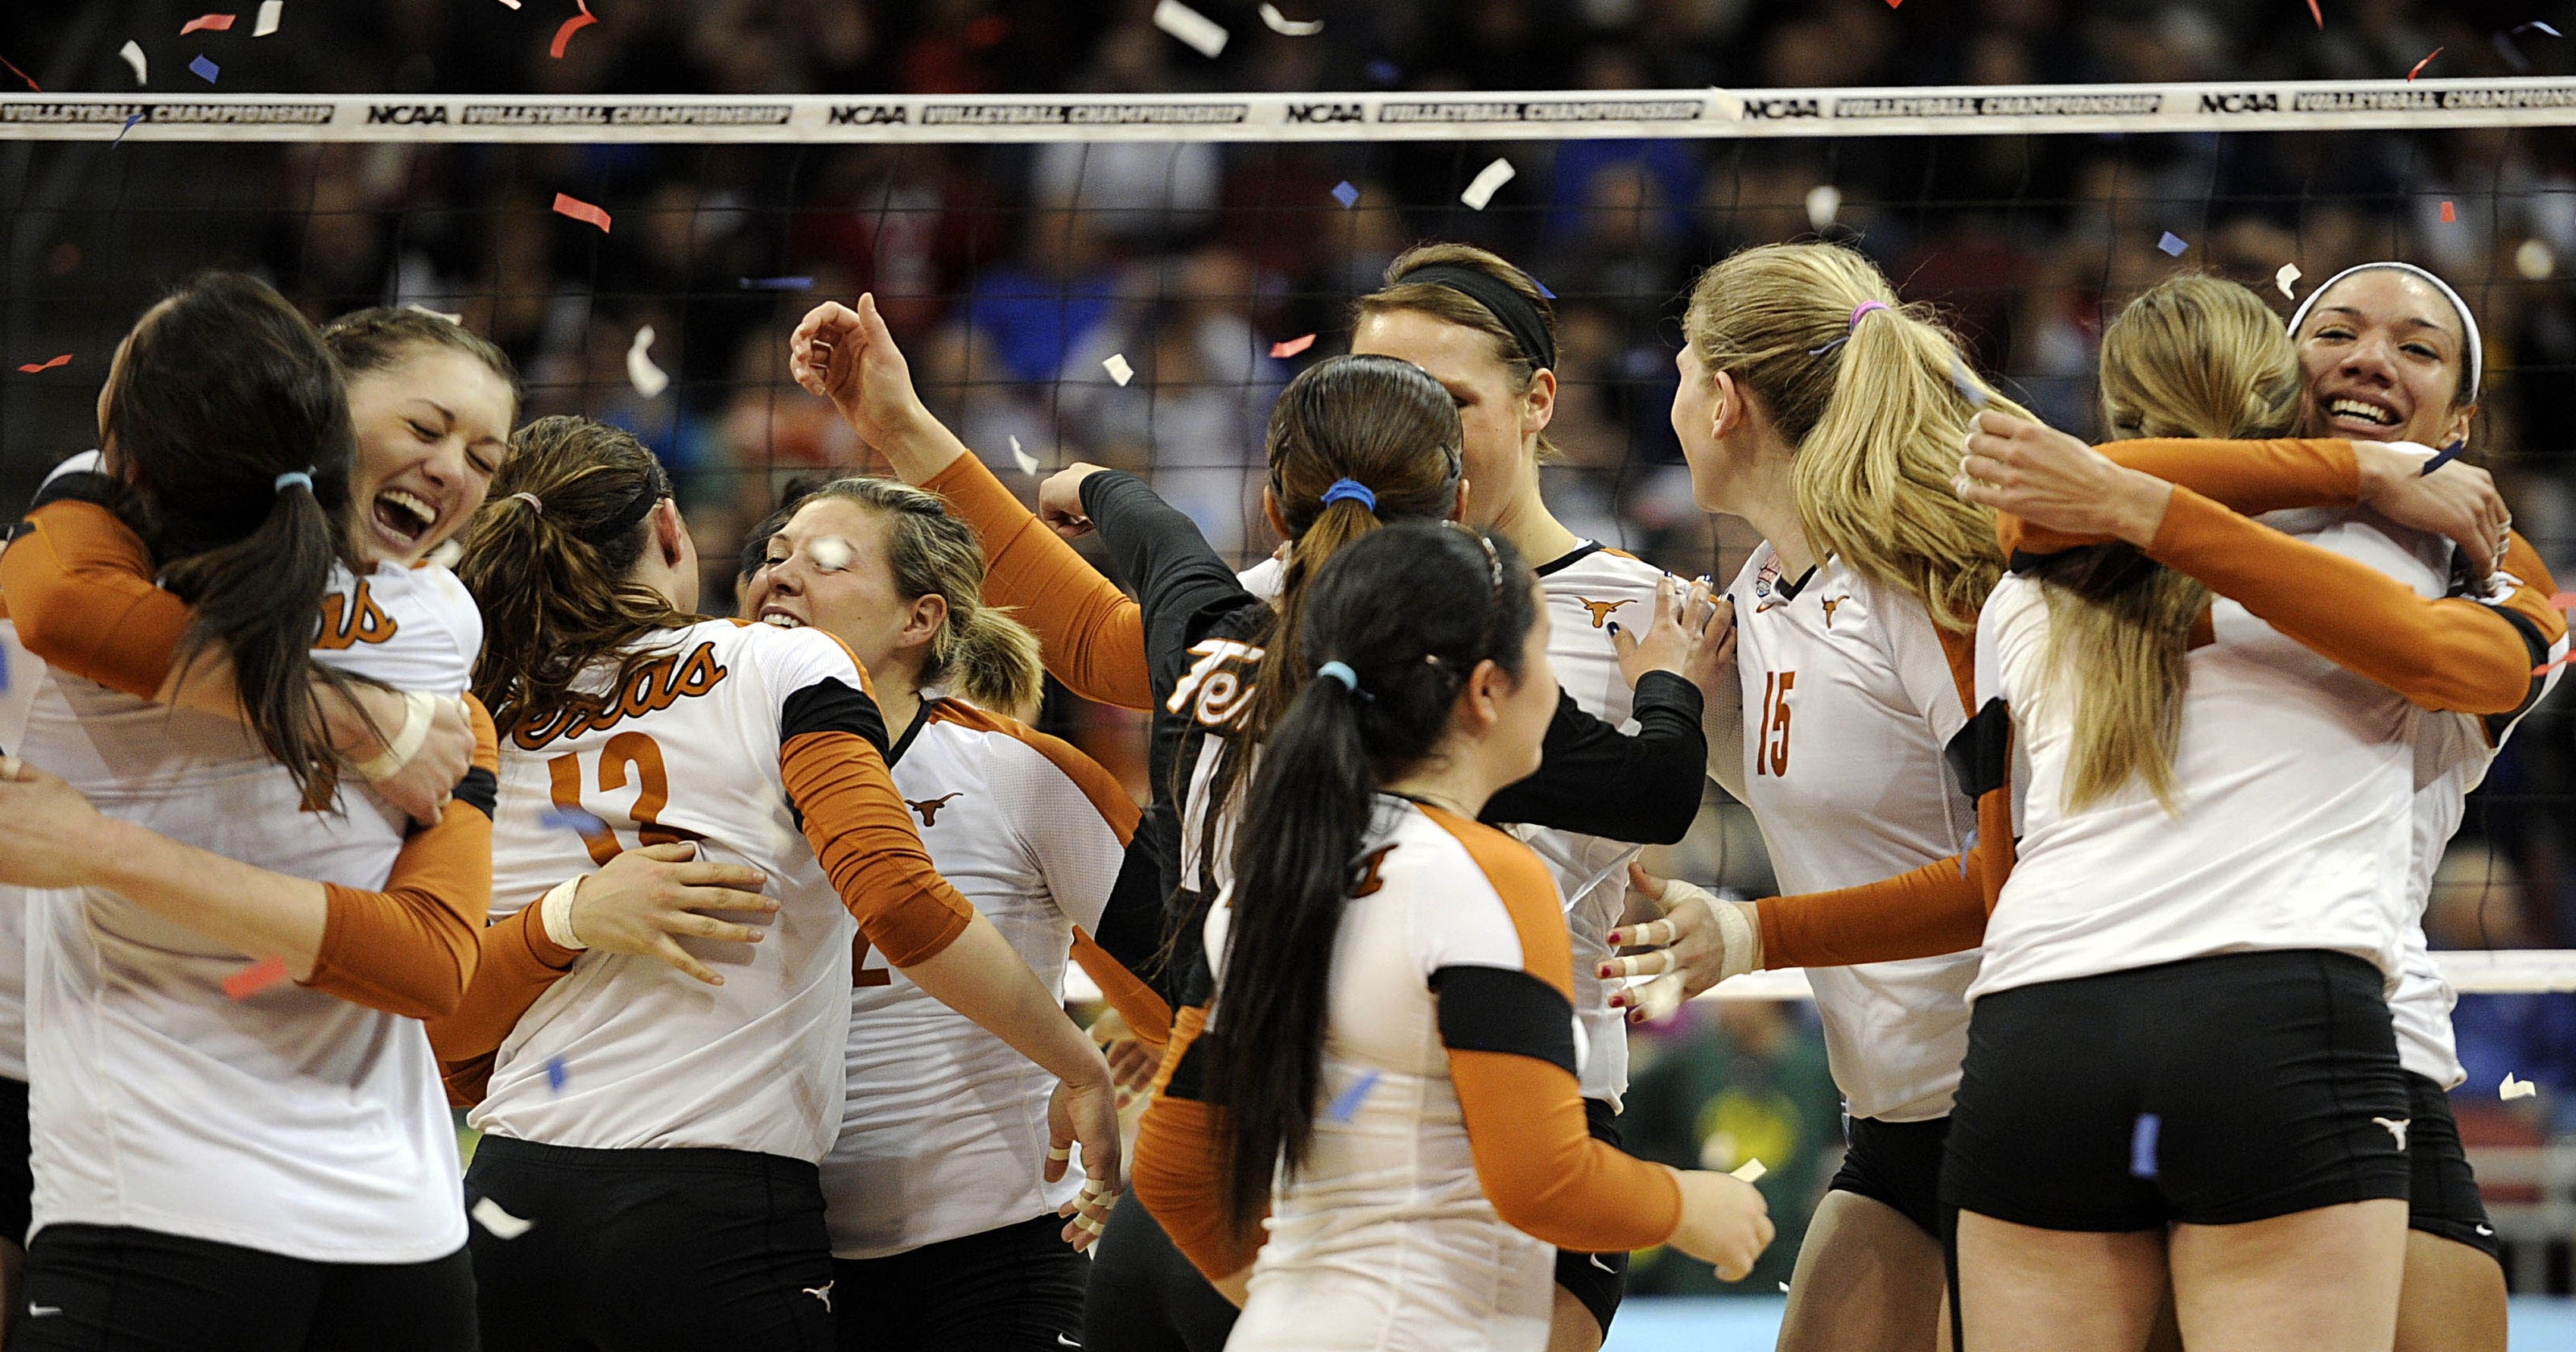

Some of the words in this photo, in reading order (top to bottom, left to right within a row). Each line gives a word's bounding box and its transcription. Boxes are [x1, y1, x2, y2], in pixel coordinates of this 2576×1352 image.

[1742, 99, 1818, 118] NCAA
[2198, 93, 2277, 113] NCAA
[150, 105, 333, 123] CHAMPIONSHIP
[367, 105, 448, 125] NCAA
[828, 105, 907, 125] NCAA
[1288, 104, 1363, 123] NCAA
[510, 641, 728, 751] exas
[1757, 670, 1796, 777] 15
